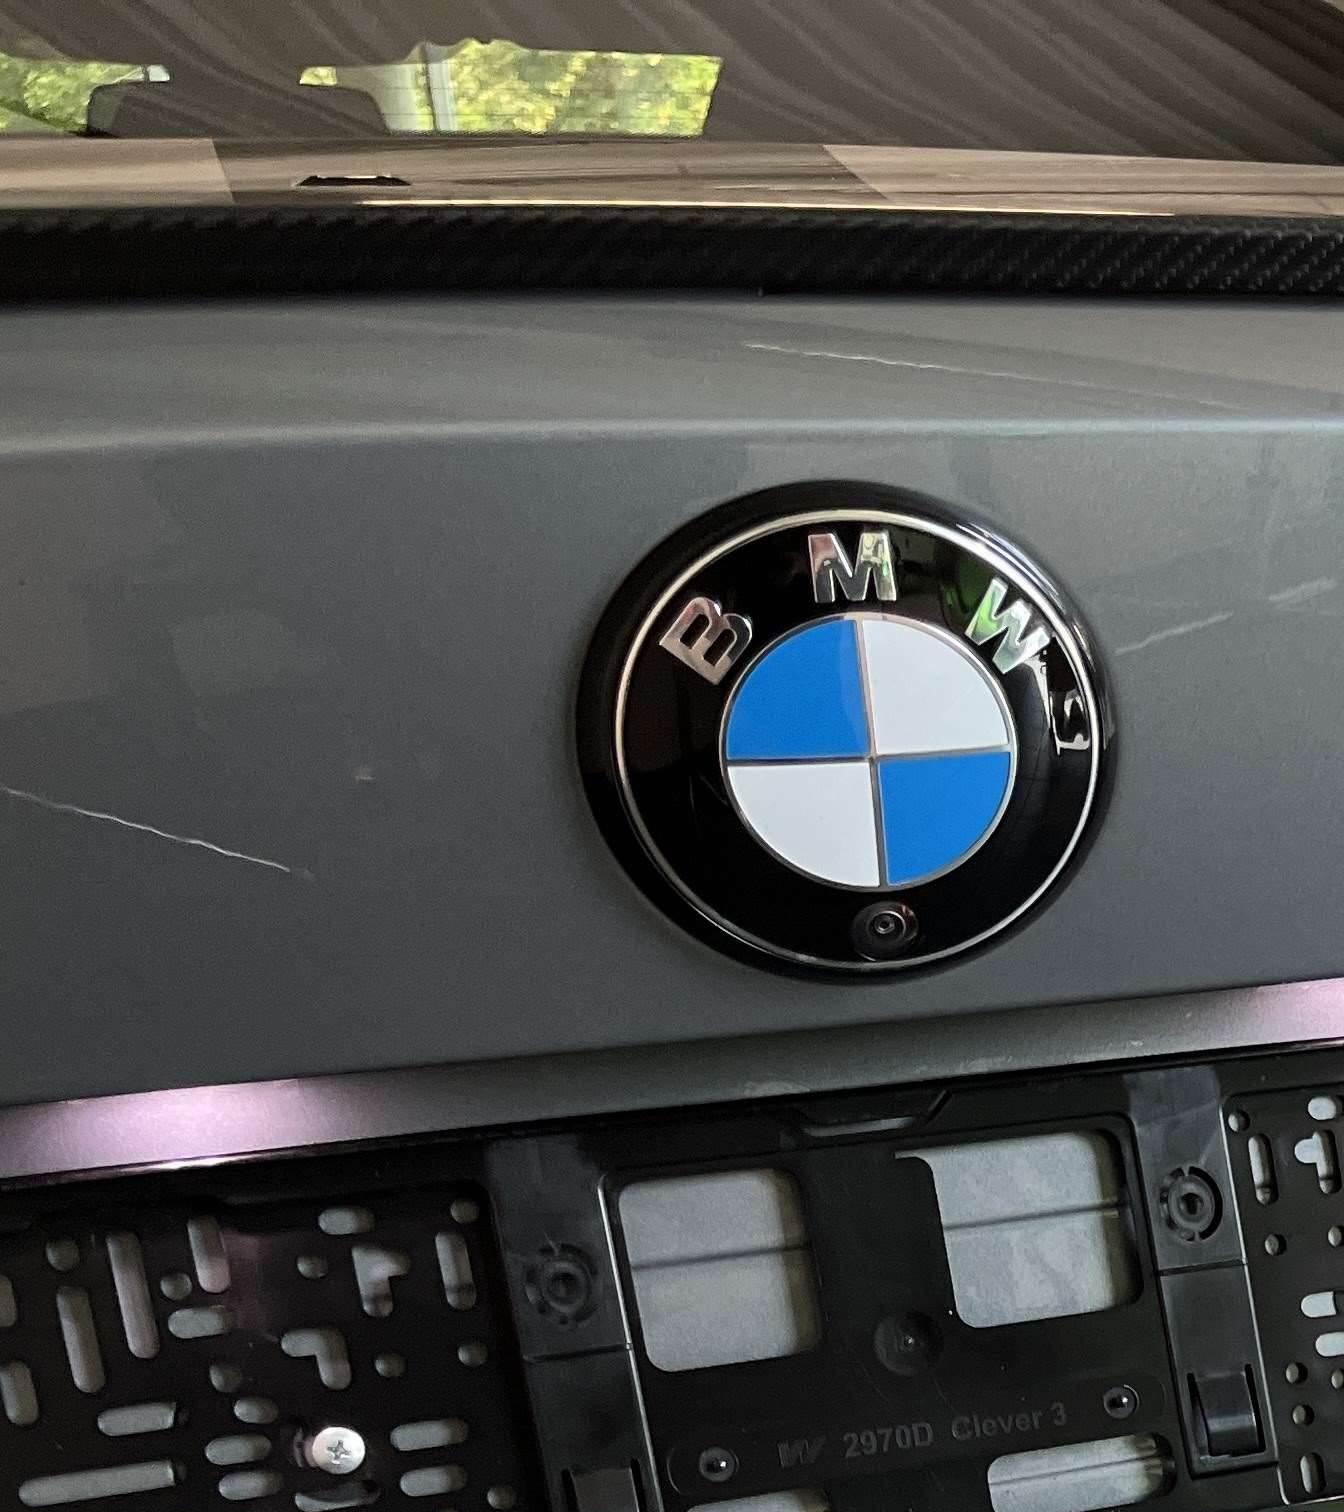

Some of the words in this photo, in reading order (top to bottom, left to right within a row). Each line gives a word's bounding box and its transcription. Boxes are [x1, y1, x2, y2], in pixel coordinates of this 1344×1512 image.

[658, 532, 1051, 686] BMW
[843, 1421, 934, 1459] 2970D
[952, 1409, 1043, 1441] Clever
[1050, 1401, 1068, 1427] 3
